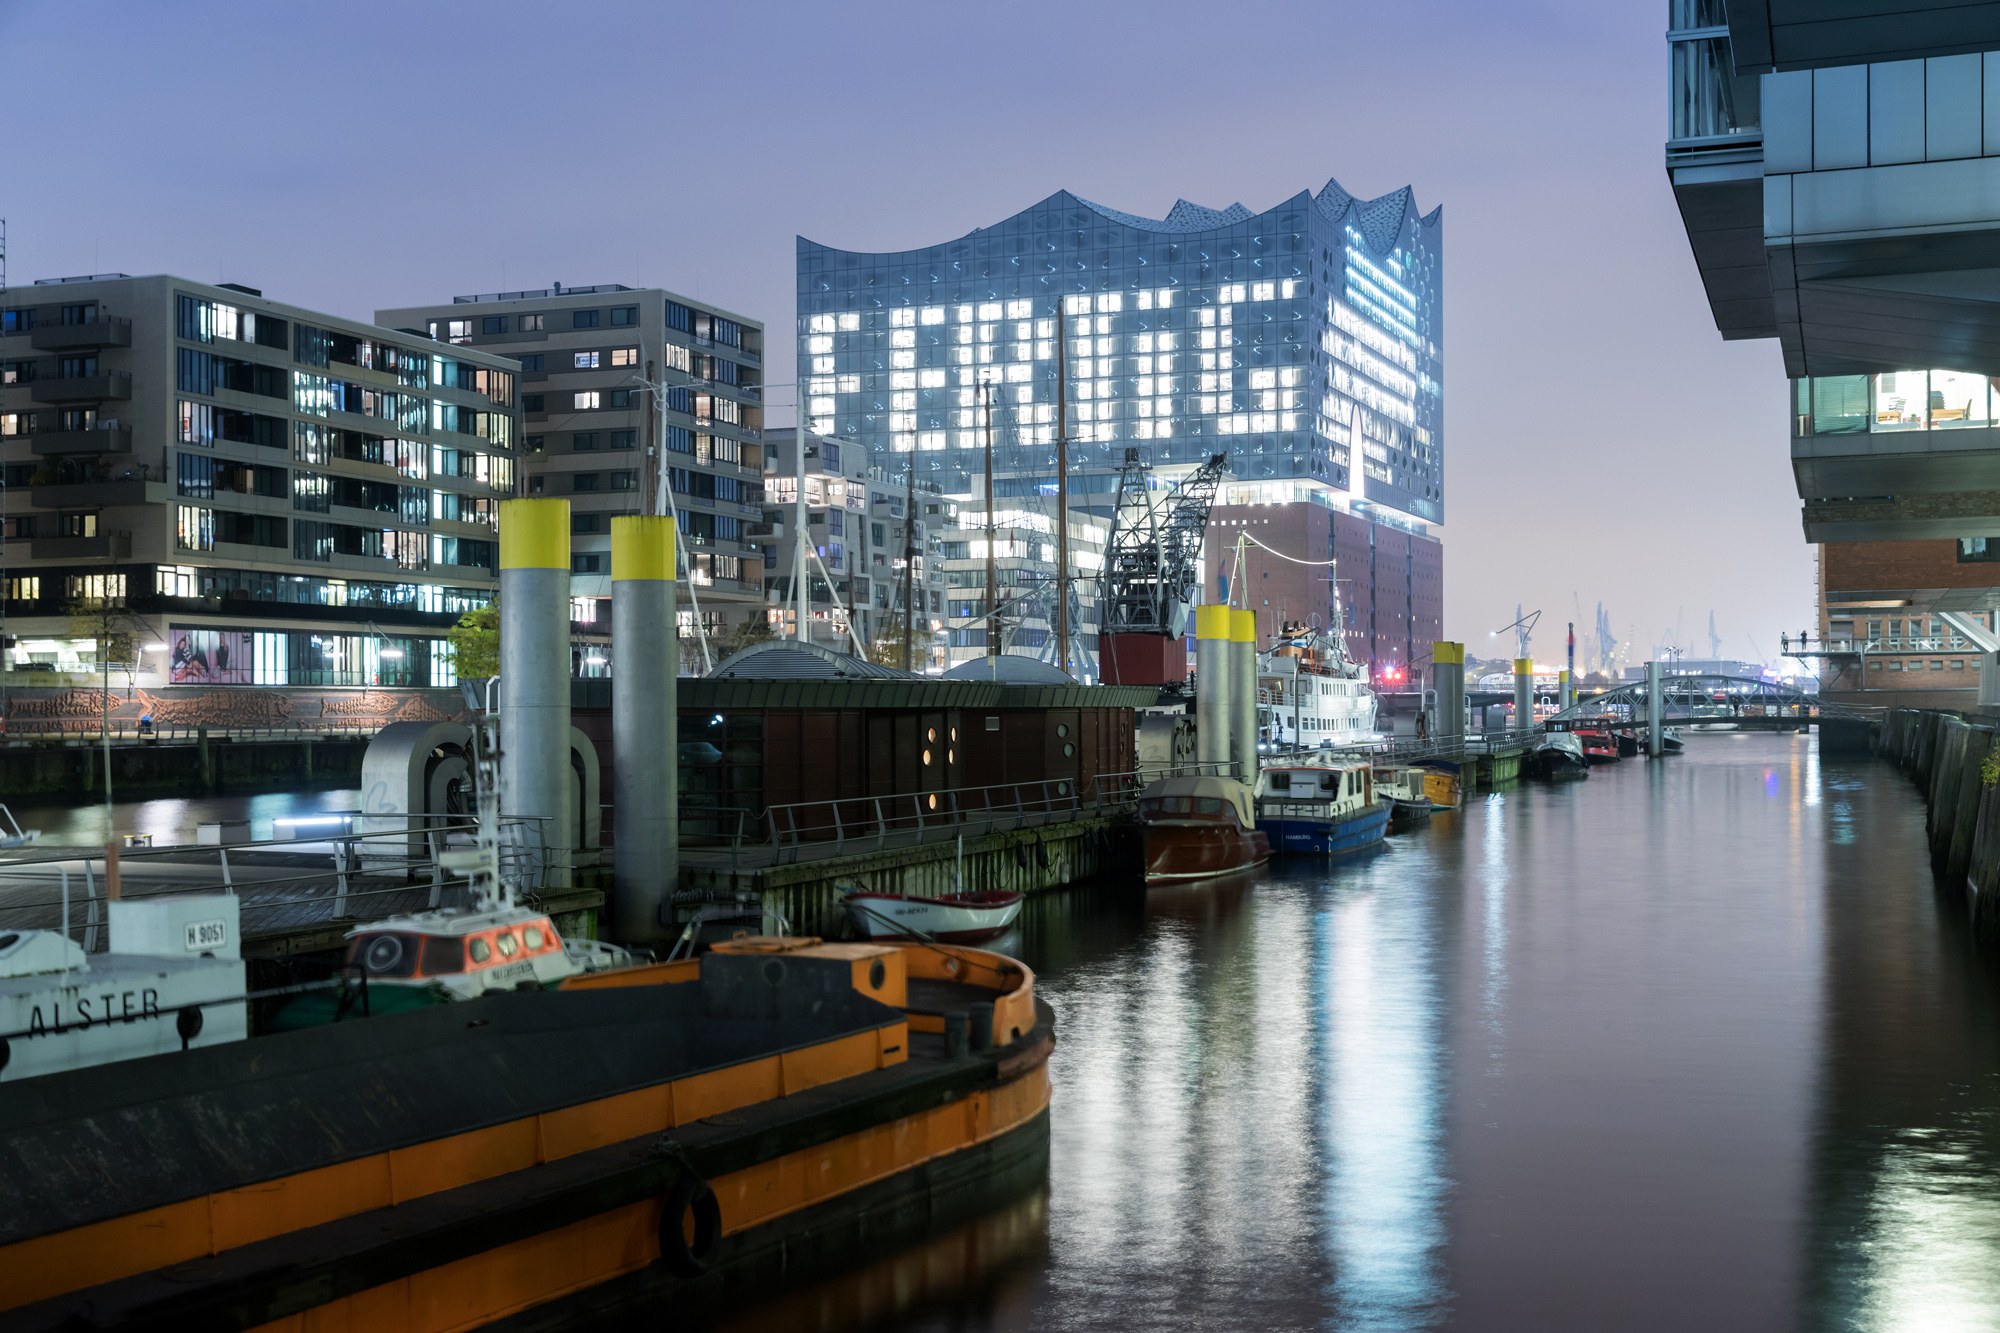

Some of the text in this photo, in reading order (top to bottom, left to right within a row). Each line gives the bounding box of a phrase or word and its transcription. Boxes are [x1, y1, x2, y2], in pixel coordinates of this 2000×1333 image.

[188, 924, 224, 944] H 9051
[28, 988, 158, 1039] ALSTER
